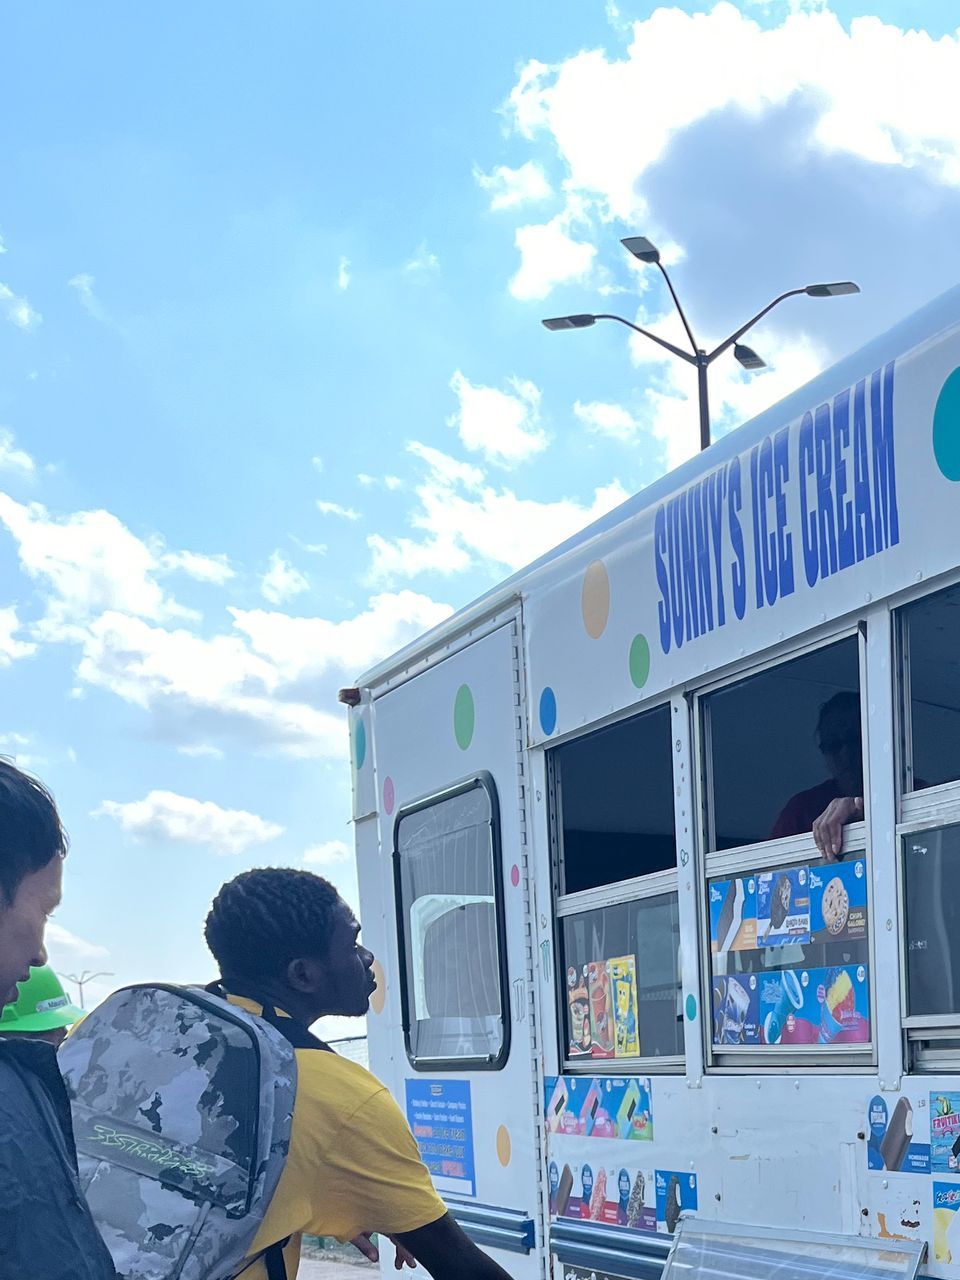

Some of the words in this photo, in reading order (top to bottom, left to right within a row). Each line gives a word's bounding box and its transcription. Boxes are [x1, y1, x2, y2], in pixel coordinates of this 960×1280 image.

[655, 456, 746, 654] SUNNY'S
[751, 427, 795, 609] ICE
[799, 360, 900, 588] CREAM
[932, 1114, 960, 1129] FRUITIKI
